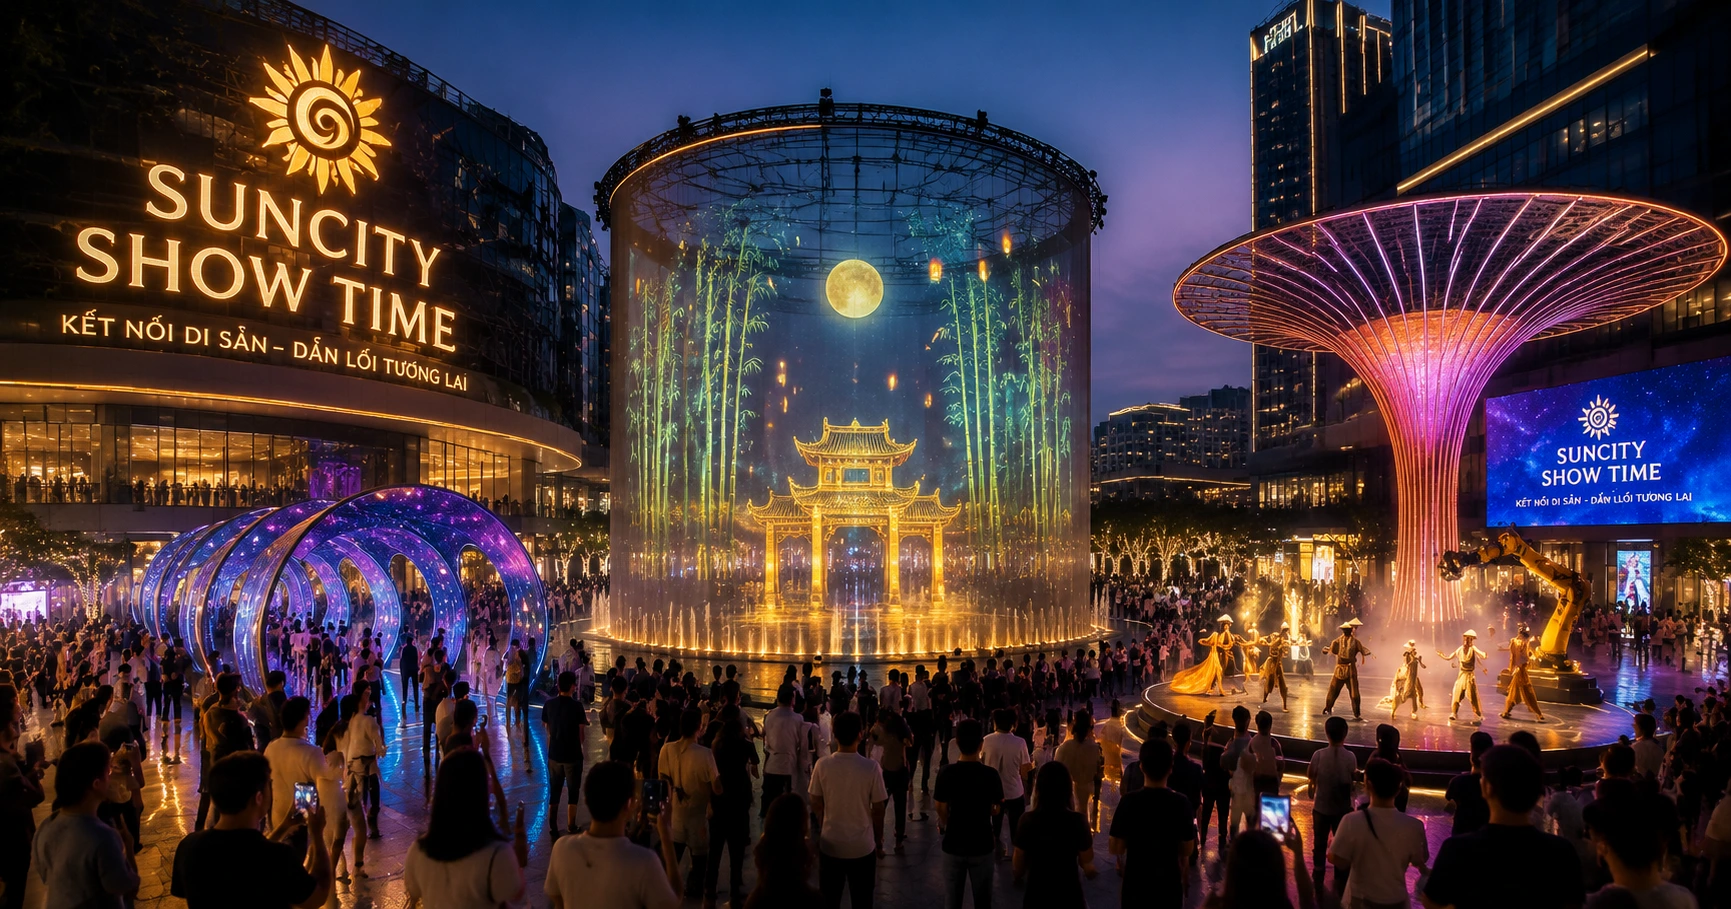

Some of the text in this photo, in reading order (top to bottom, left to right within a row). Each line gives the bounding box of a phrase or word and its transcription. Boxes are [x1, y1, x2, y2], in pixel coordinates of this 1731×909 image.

[146, 163, 441, 288] SUNCITY
[76, 227, 457, 353] SHOW TIME
[185, 326, 209, 346] DI
[1557, 440, 1647, 465] SUNCITY
[1541, 462, 1662, 487] SHOW TIME
[1675, 492, 1693, 502] LAI
